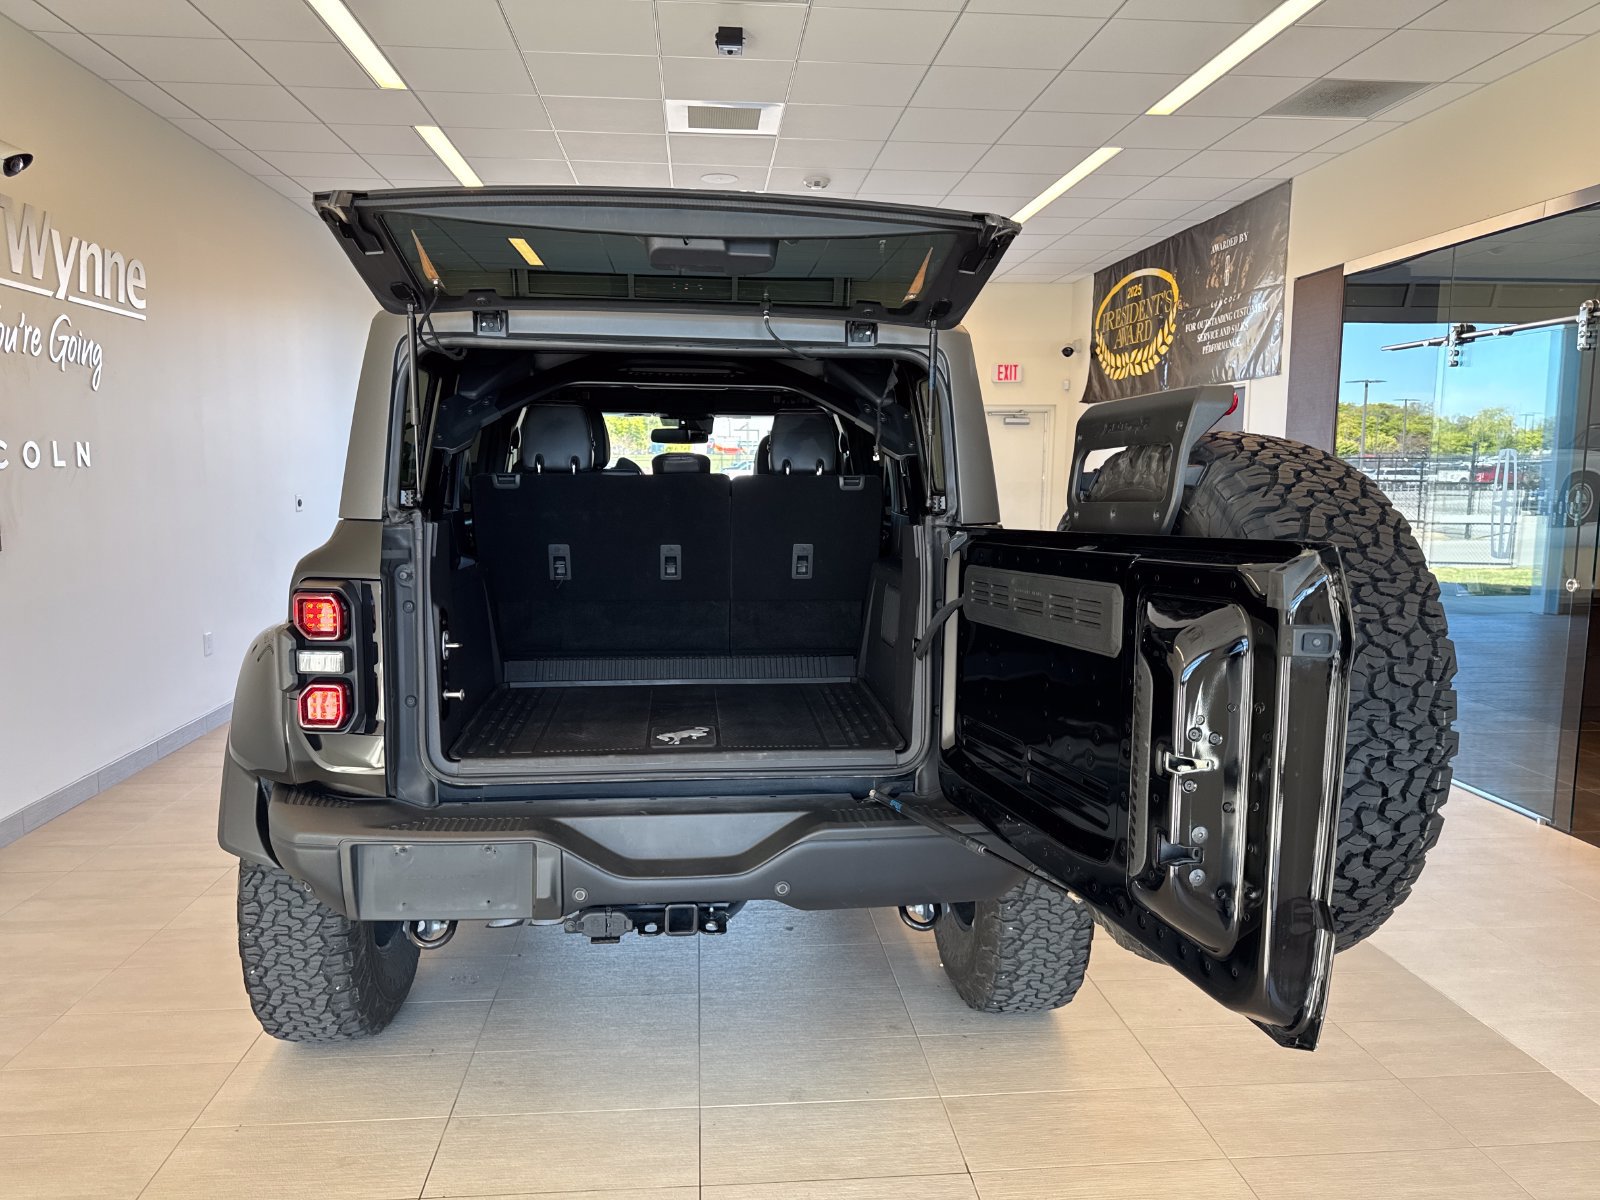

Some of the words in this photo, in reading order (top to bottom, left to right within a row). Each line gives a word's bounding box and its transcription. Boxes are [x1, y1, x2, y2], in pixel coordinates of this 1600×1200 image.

[0, 193, 147, 309] Wynne
[1211, 234, 1239, 255] AWARDED
[1239, 231, 1249, 244] BY
[1127, 284, 1142, 299] 2025
[1102, 290, 1172, 333] PRESIDENT'S
[1185, 322, 1197, 333] FOR
[1197, 311, 1233, 329] OUTSTANDING
[1113, 320, 1152, 349] AWARD
[1197, 328, 1220, 343] SERVICE
[1220, 324, 1232, 338] AND
[0, 312, 42, 357] ou're
[50, 314, 103, 391] Going
[997, 364, 1018, 381] EXIT
